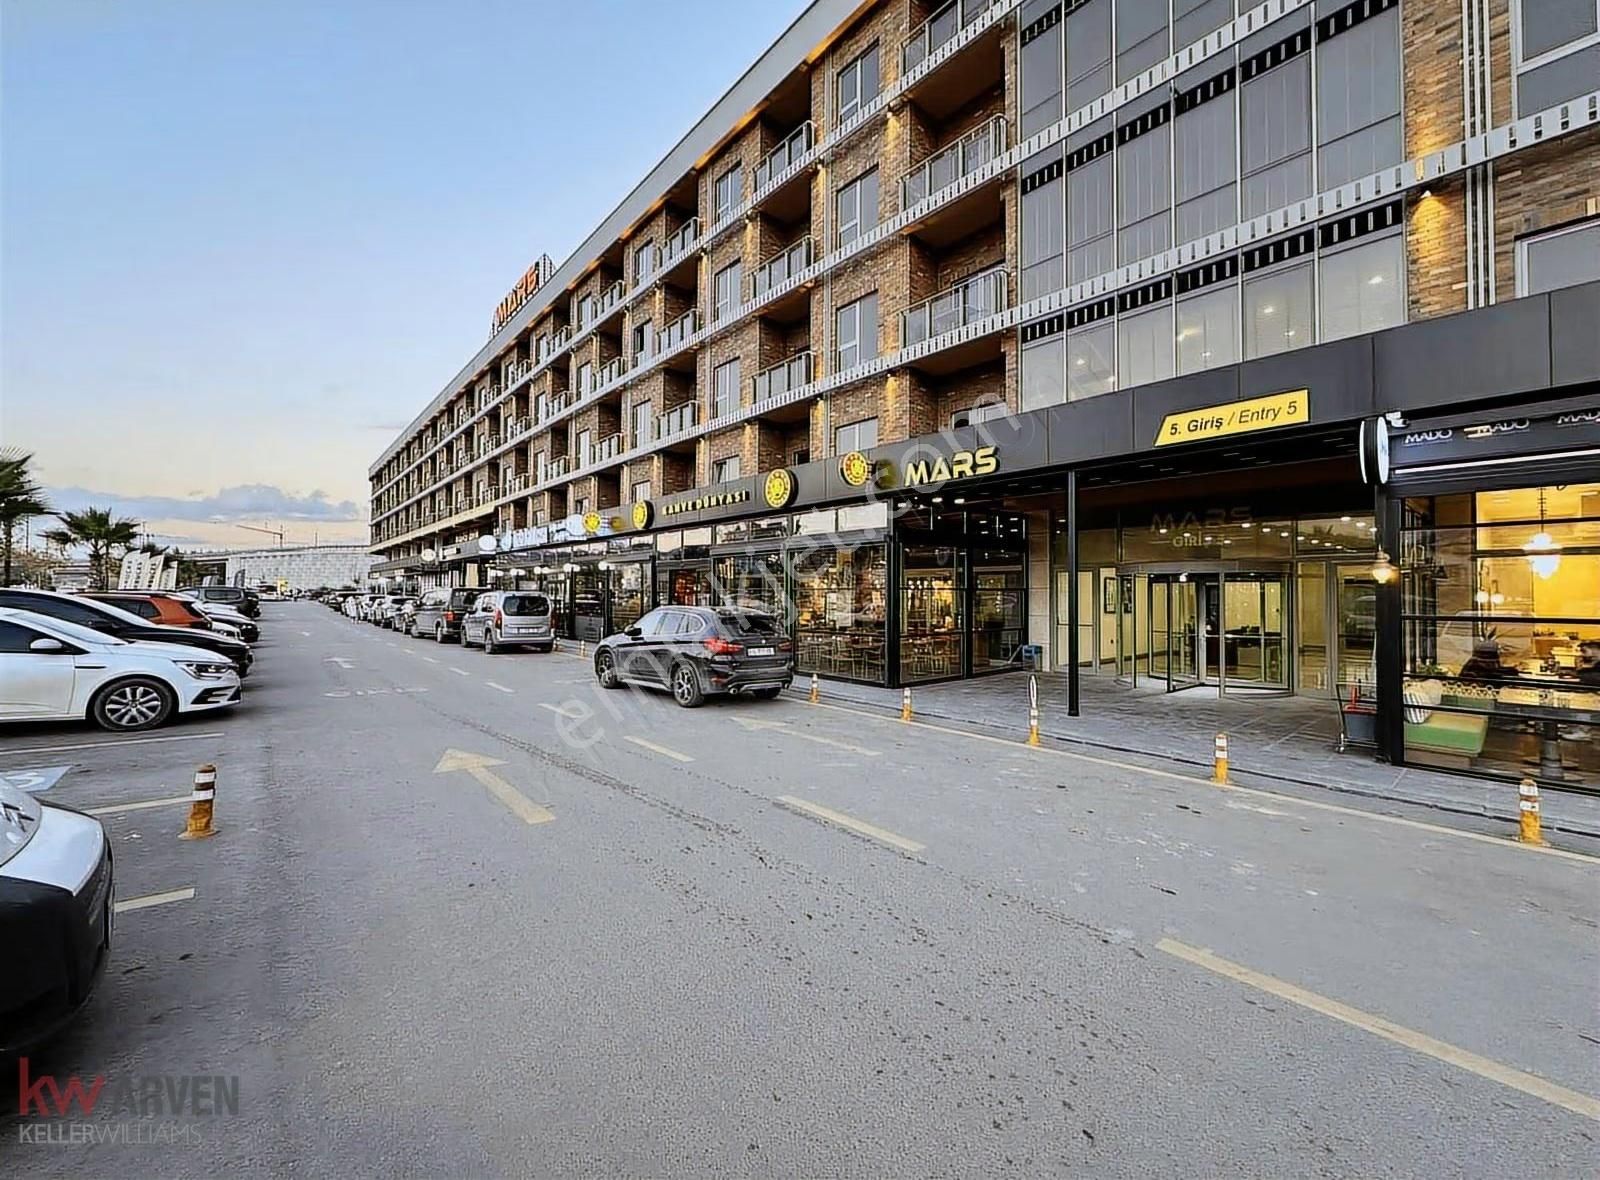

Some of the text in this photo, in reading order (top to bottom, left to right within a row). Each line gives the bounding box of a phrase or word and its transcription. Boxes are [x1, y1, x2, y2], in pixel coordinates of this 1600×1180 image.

[1170, 401, 1297, 436] 5. Giriş / Entry 5
[1404, 429, 1453, 444] MADO
[904, 446, 996, 487] MARS
